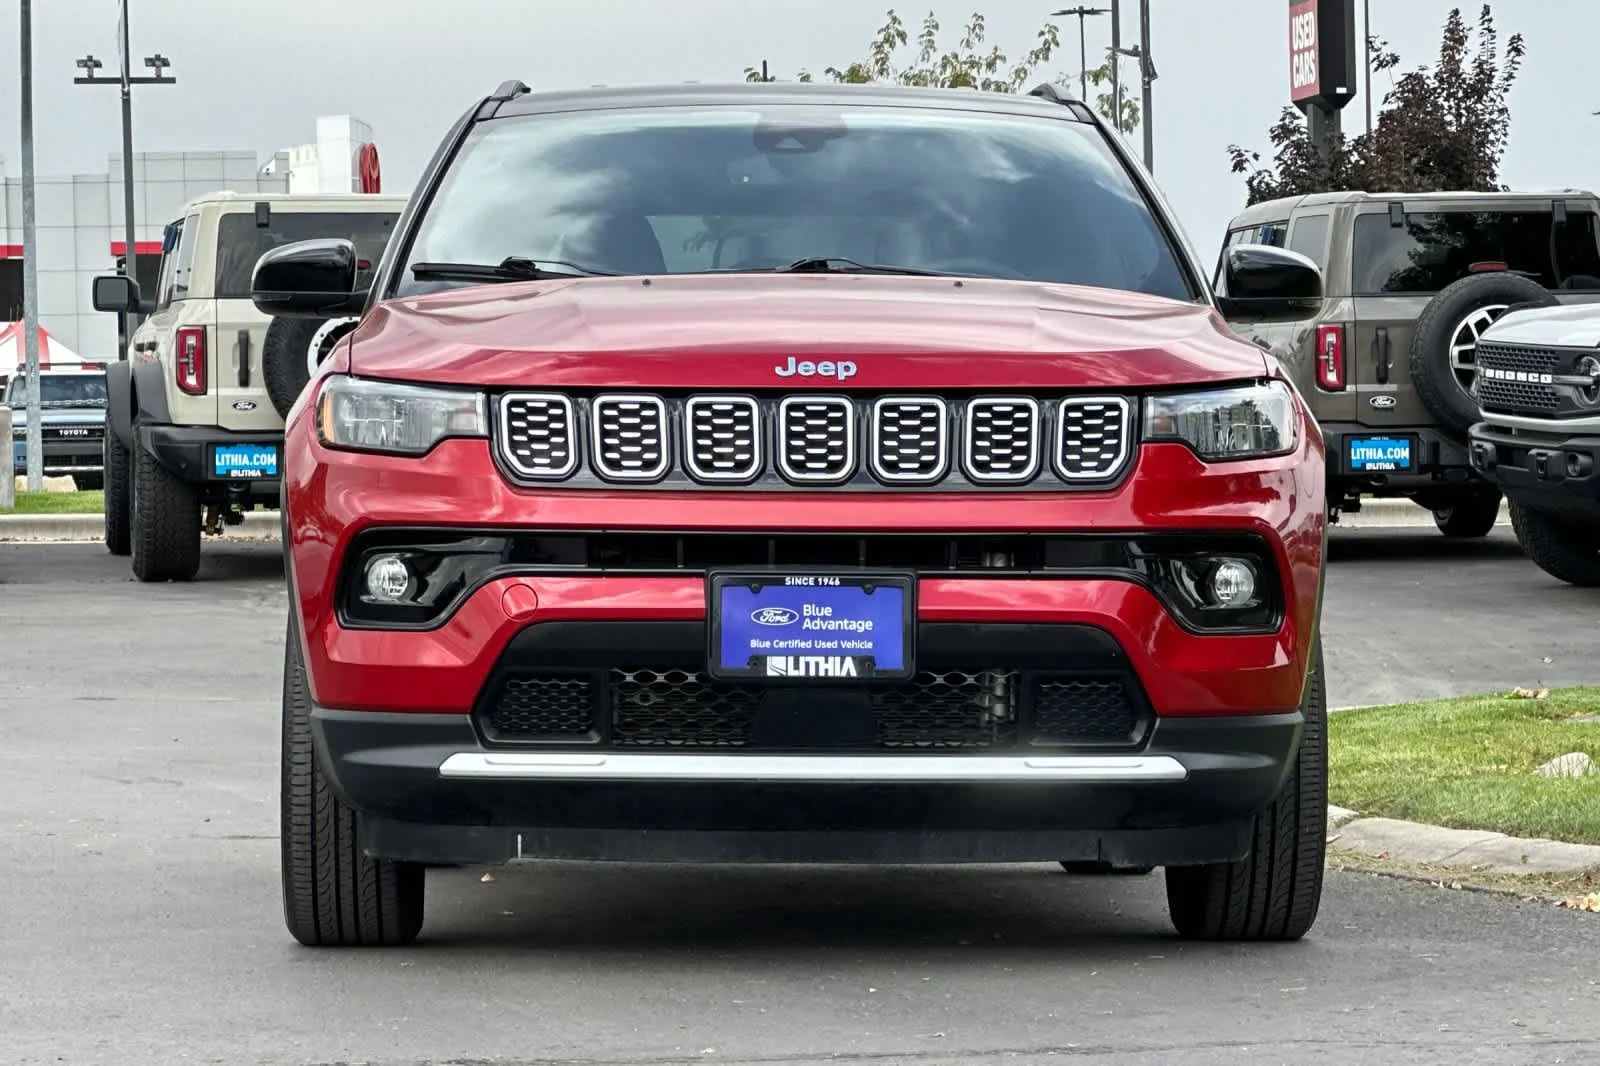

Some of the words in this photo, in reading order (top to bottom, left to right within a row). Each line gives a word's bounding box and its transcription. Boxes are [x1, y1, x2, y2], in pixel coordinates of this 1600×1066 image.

[1292, 11, 1315, 51] USED
[1293, 49, 1316, 89] CARS
[774, 356, 857, 381] Jeep
[1485, 368, 1553, 384] BRONCO
[215, 453, 277, 466] LITHIA.COM
[1351, 447, 1410, 460] LITHIA.COM
[238, 469, 262, 477] LITHIA
[1374, 462, 1396, 471] LITHIA
[785, 577, 815, 586] SINCE
[817, 577, 841, 586] 1946
[802, 604, 833, 617] Blue
[802, 618, 873, 632] Advantage
[750, 639, 771, 649] Blue
[773, 639, 812, 649] Certified
[814, 639, 838, 649] Used
[840, 639, 873, 649] Vehicle
[787, 656, 857, 677] LITHIA
